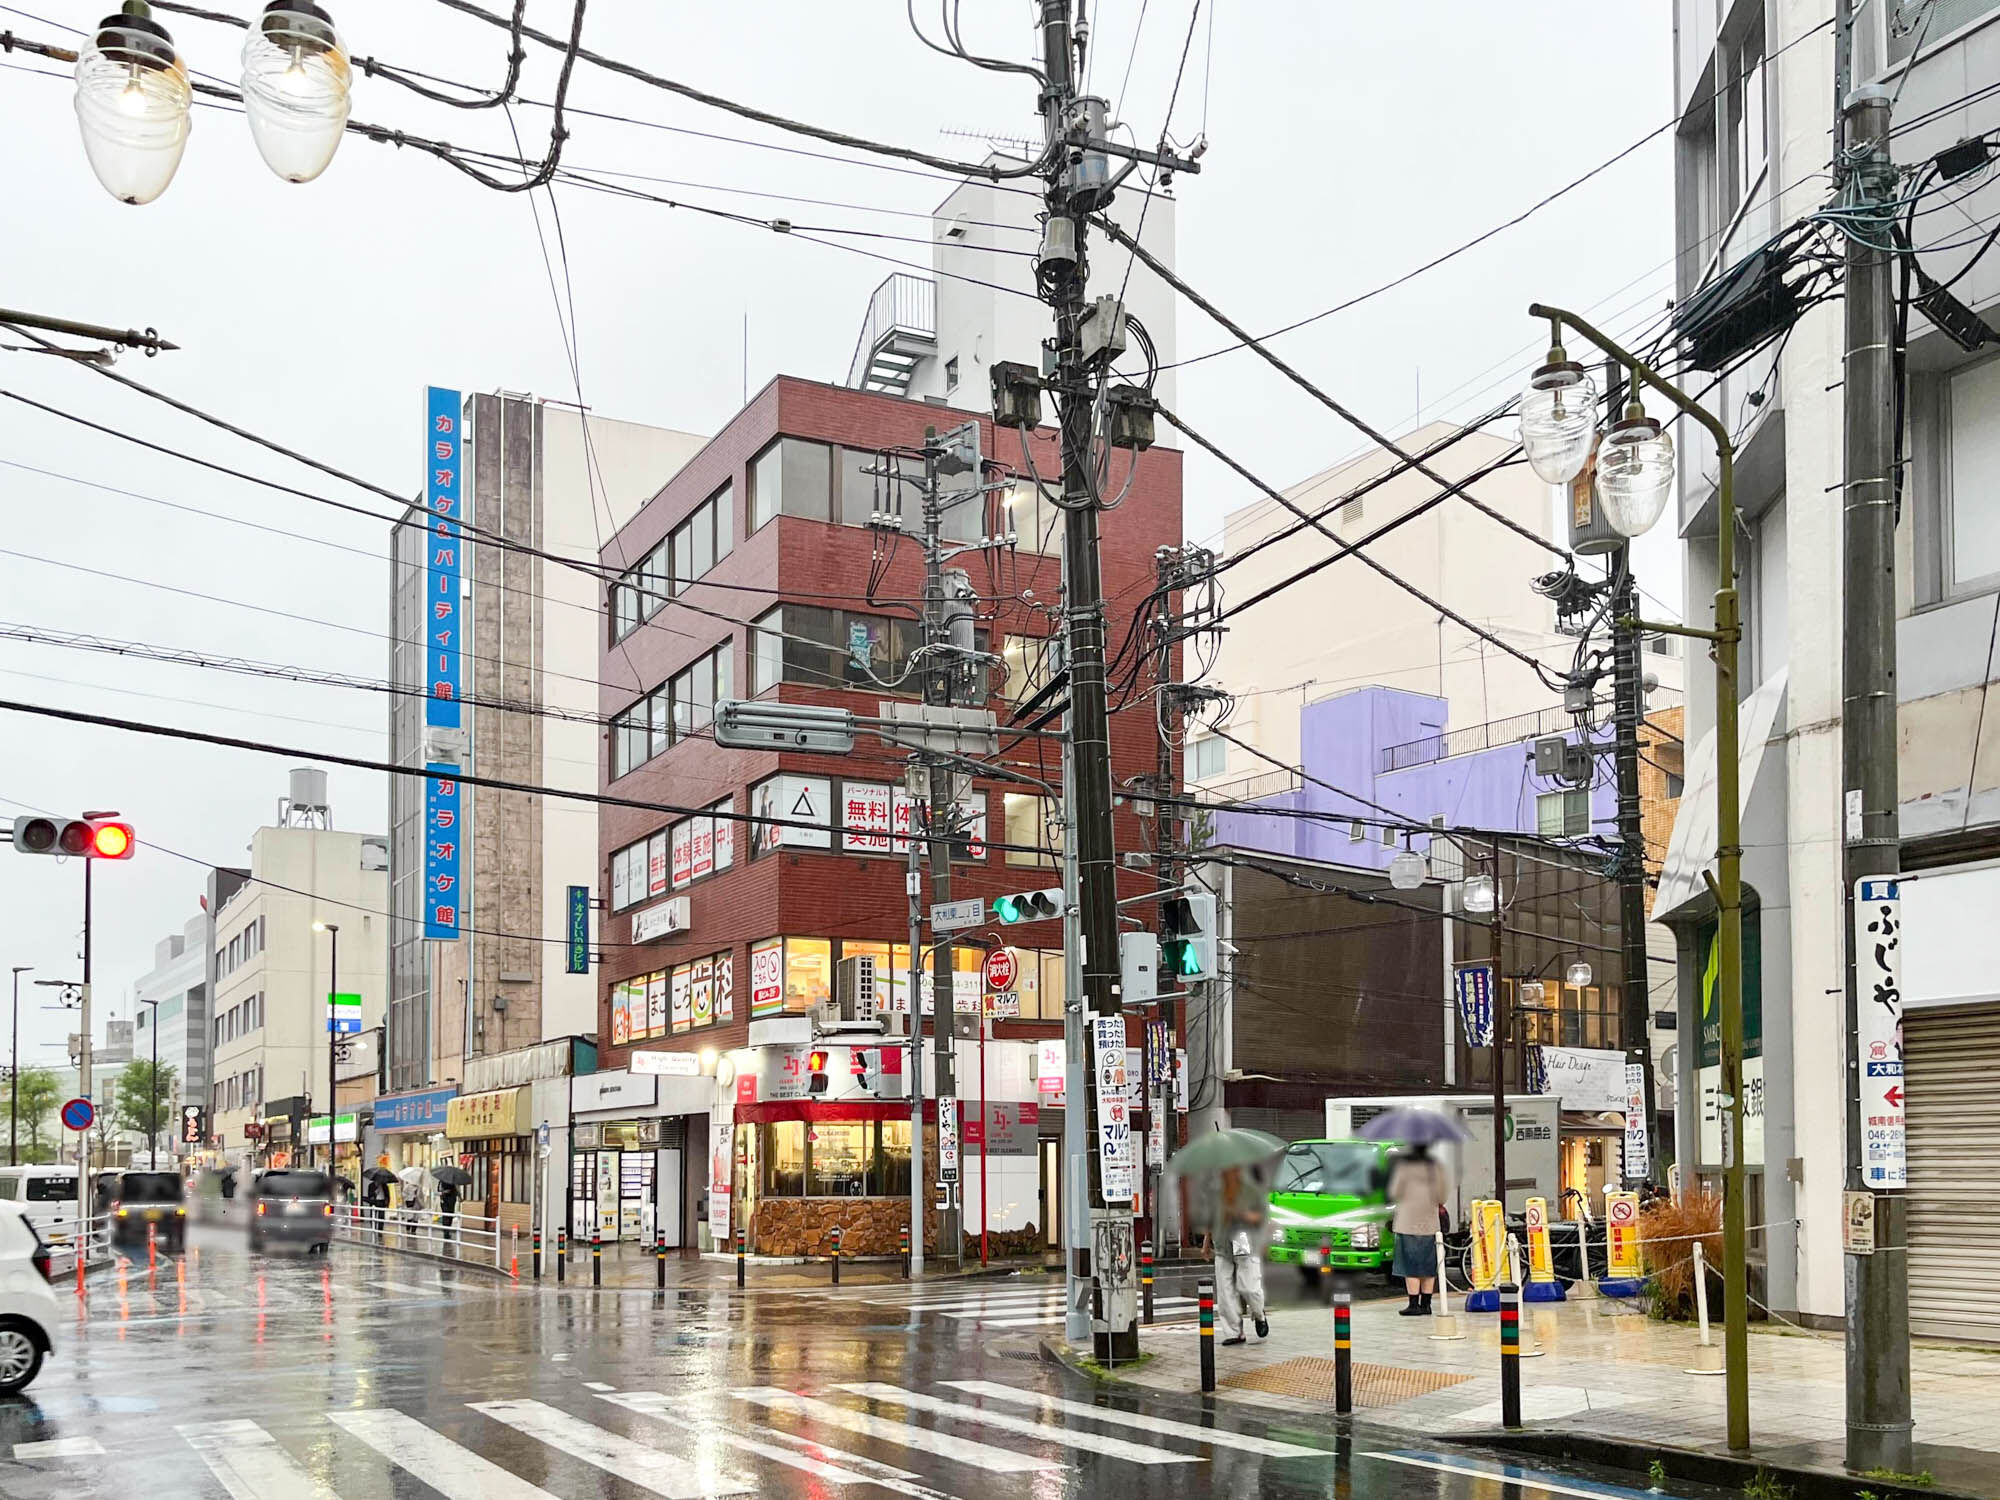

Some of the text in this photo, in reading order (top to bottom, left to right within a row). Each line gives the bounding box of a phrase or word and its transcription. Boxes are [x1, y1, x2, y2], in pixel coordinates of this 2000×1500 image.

[847, 786, 906, 798] パーソナルトレー
[847, 799, 932, 825] 無料体
[436, 779, 456, 924] カラオケ館
[989, 961, 1010, 978] 消火栓
[1867, 904, 1900, 1016] ふじや
